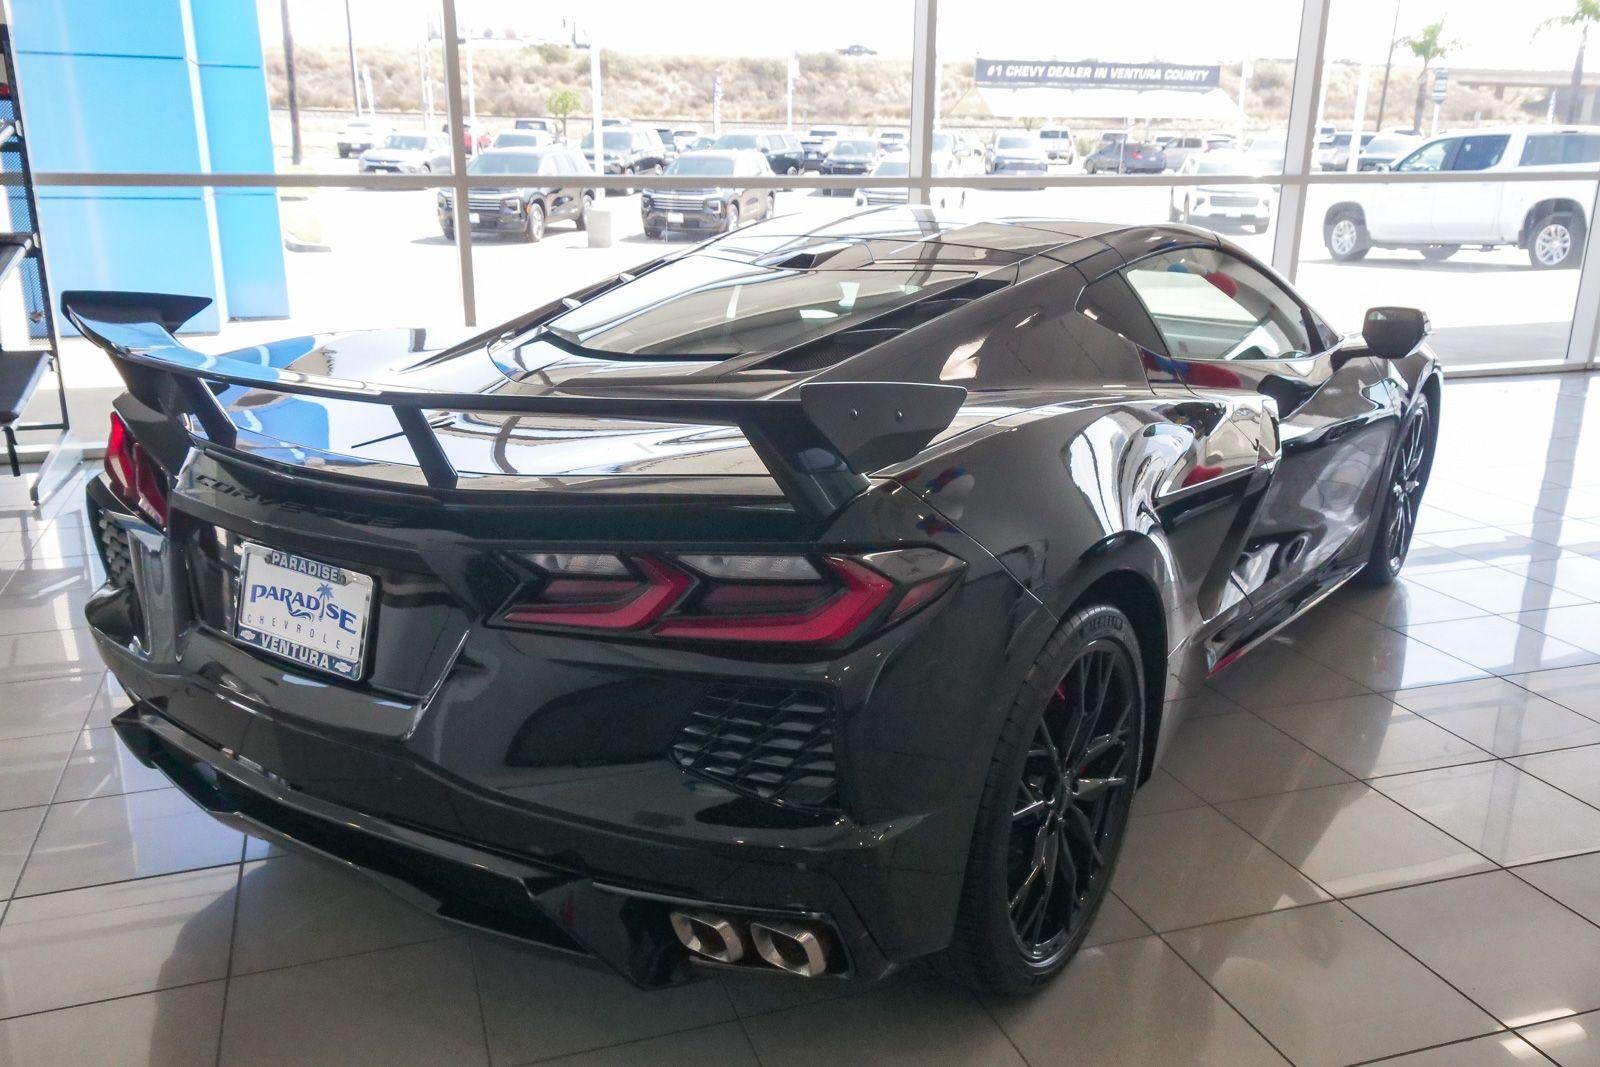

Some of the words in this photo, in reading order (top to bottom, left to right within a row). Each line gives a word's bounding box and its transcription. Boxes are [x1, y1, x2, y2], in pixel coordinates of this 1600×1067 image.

[986, 65, 1002, 77] #1
[1005, 65, 1045, 78] CHEVY
[1047, 66, 1091, 78] DEALER
[1094, 67, 1108, 79] IN
[1110, 68, 1162, 81] VENTURA
[1164, 69, 1210, 82] COUNTY
[271, 551, 339, 582] PARADISE
[250, 583, 358, 635] PARADISE
[246, 613, 355, 656] CHEVROLET
[260, 633, 330, 669] VENTURA
